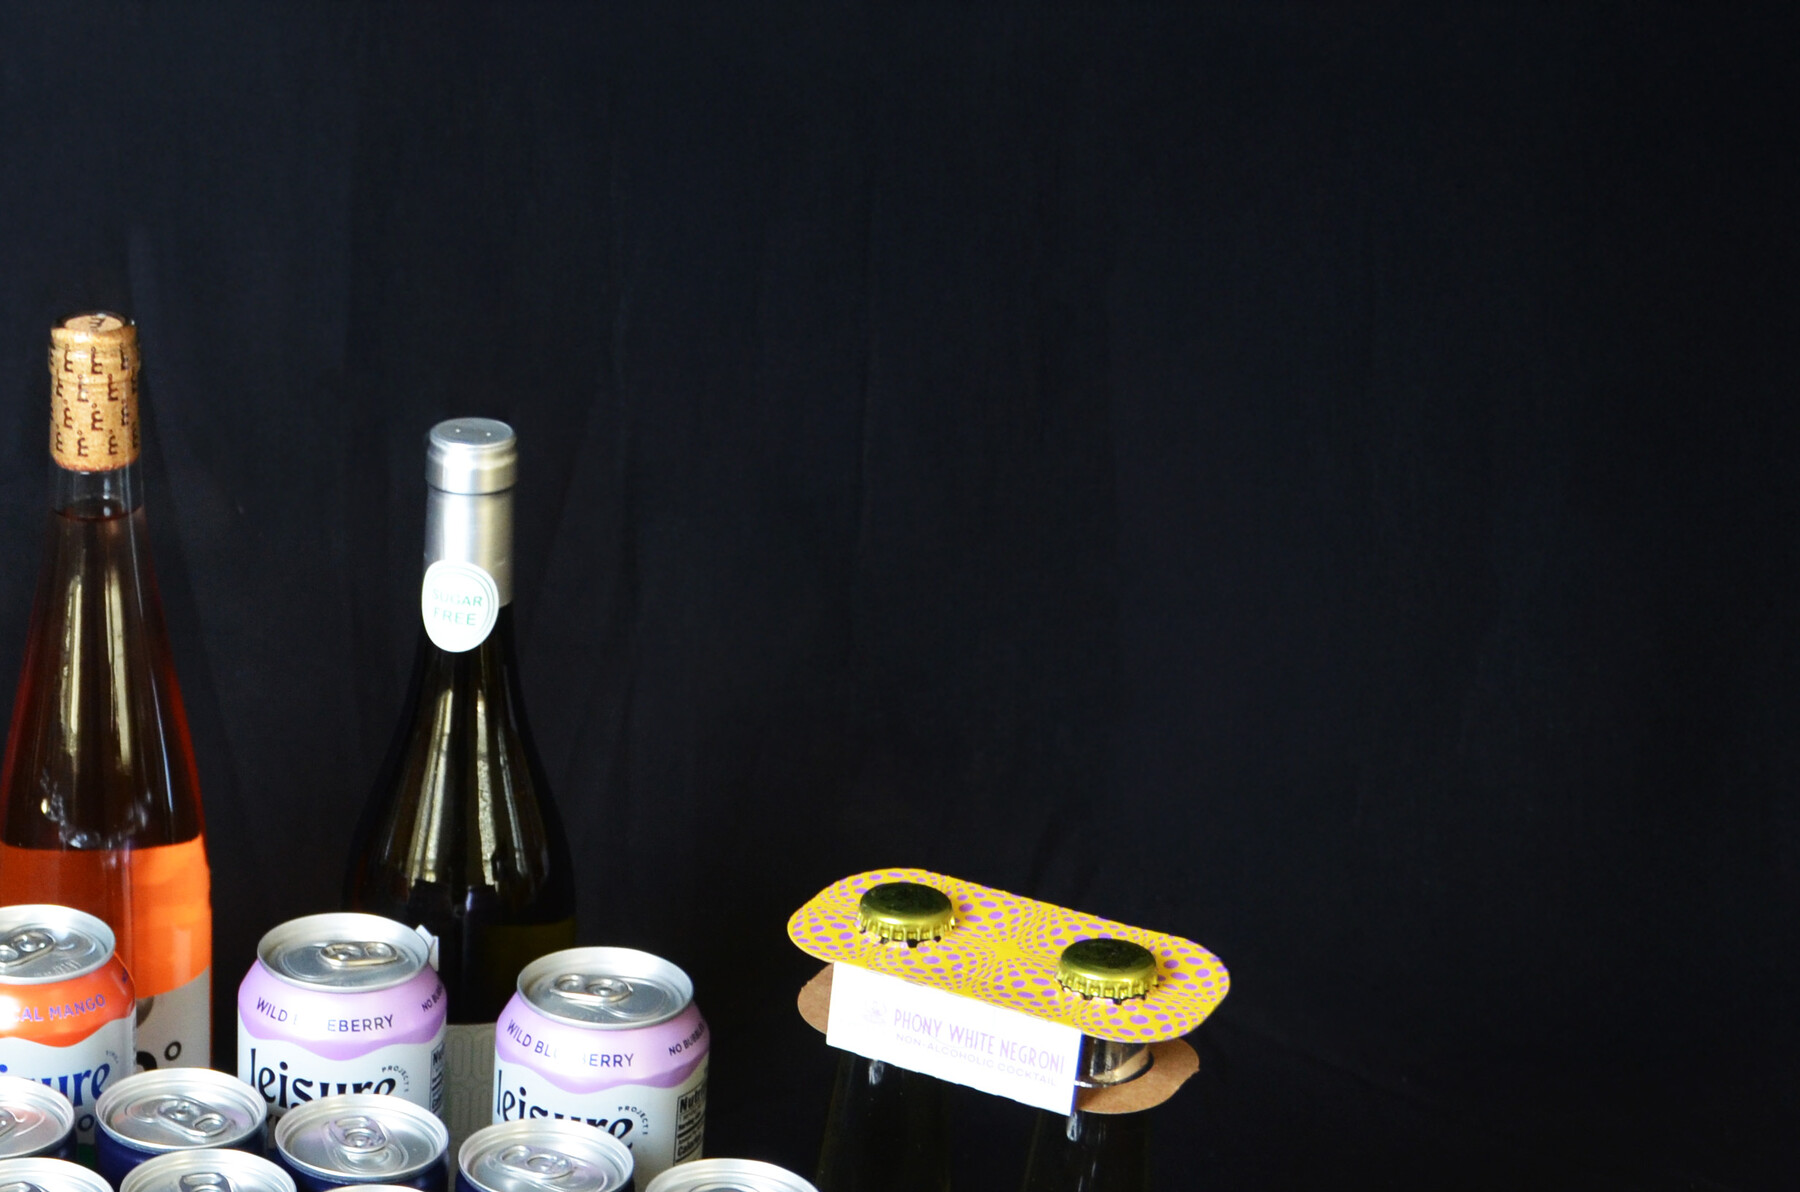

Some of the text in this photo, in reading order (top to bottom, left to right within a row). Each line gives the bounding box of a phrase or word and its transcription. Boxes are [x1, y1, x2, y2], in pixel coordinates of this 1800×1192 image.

[432, 588, 483, 607] SUGAR
[433, 607, 477, 626] FREE
[49, 993, 106, 1020] MANGO
[256, 997, 288, 1022] WILD
[506, 1019, 532, 1047] WILD
[893, 1008, 943, 1037] PHONY
[949, 1023, 995, 1055] WHITE
[1000, 1039, 1065, 1075] NEGRONI
[668, 1043, 682, 1057] NO
[896, 1033, 1057, 1087] NON-ALCOHOLIC COCKTAIL
